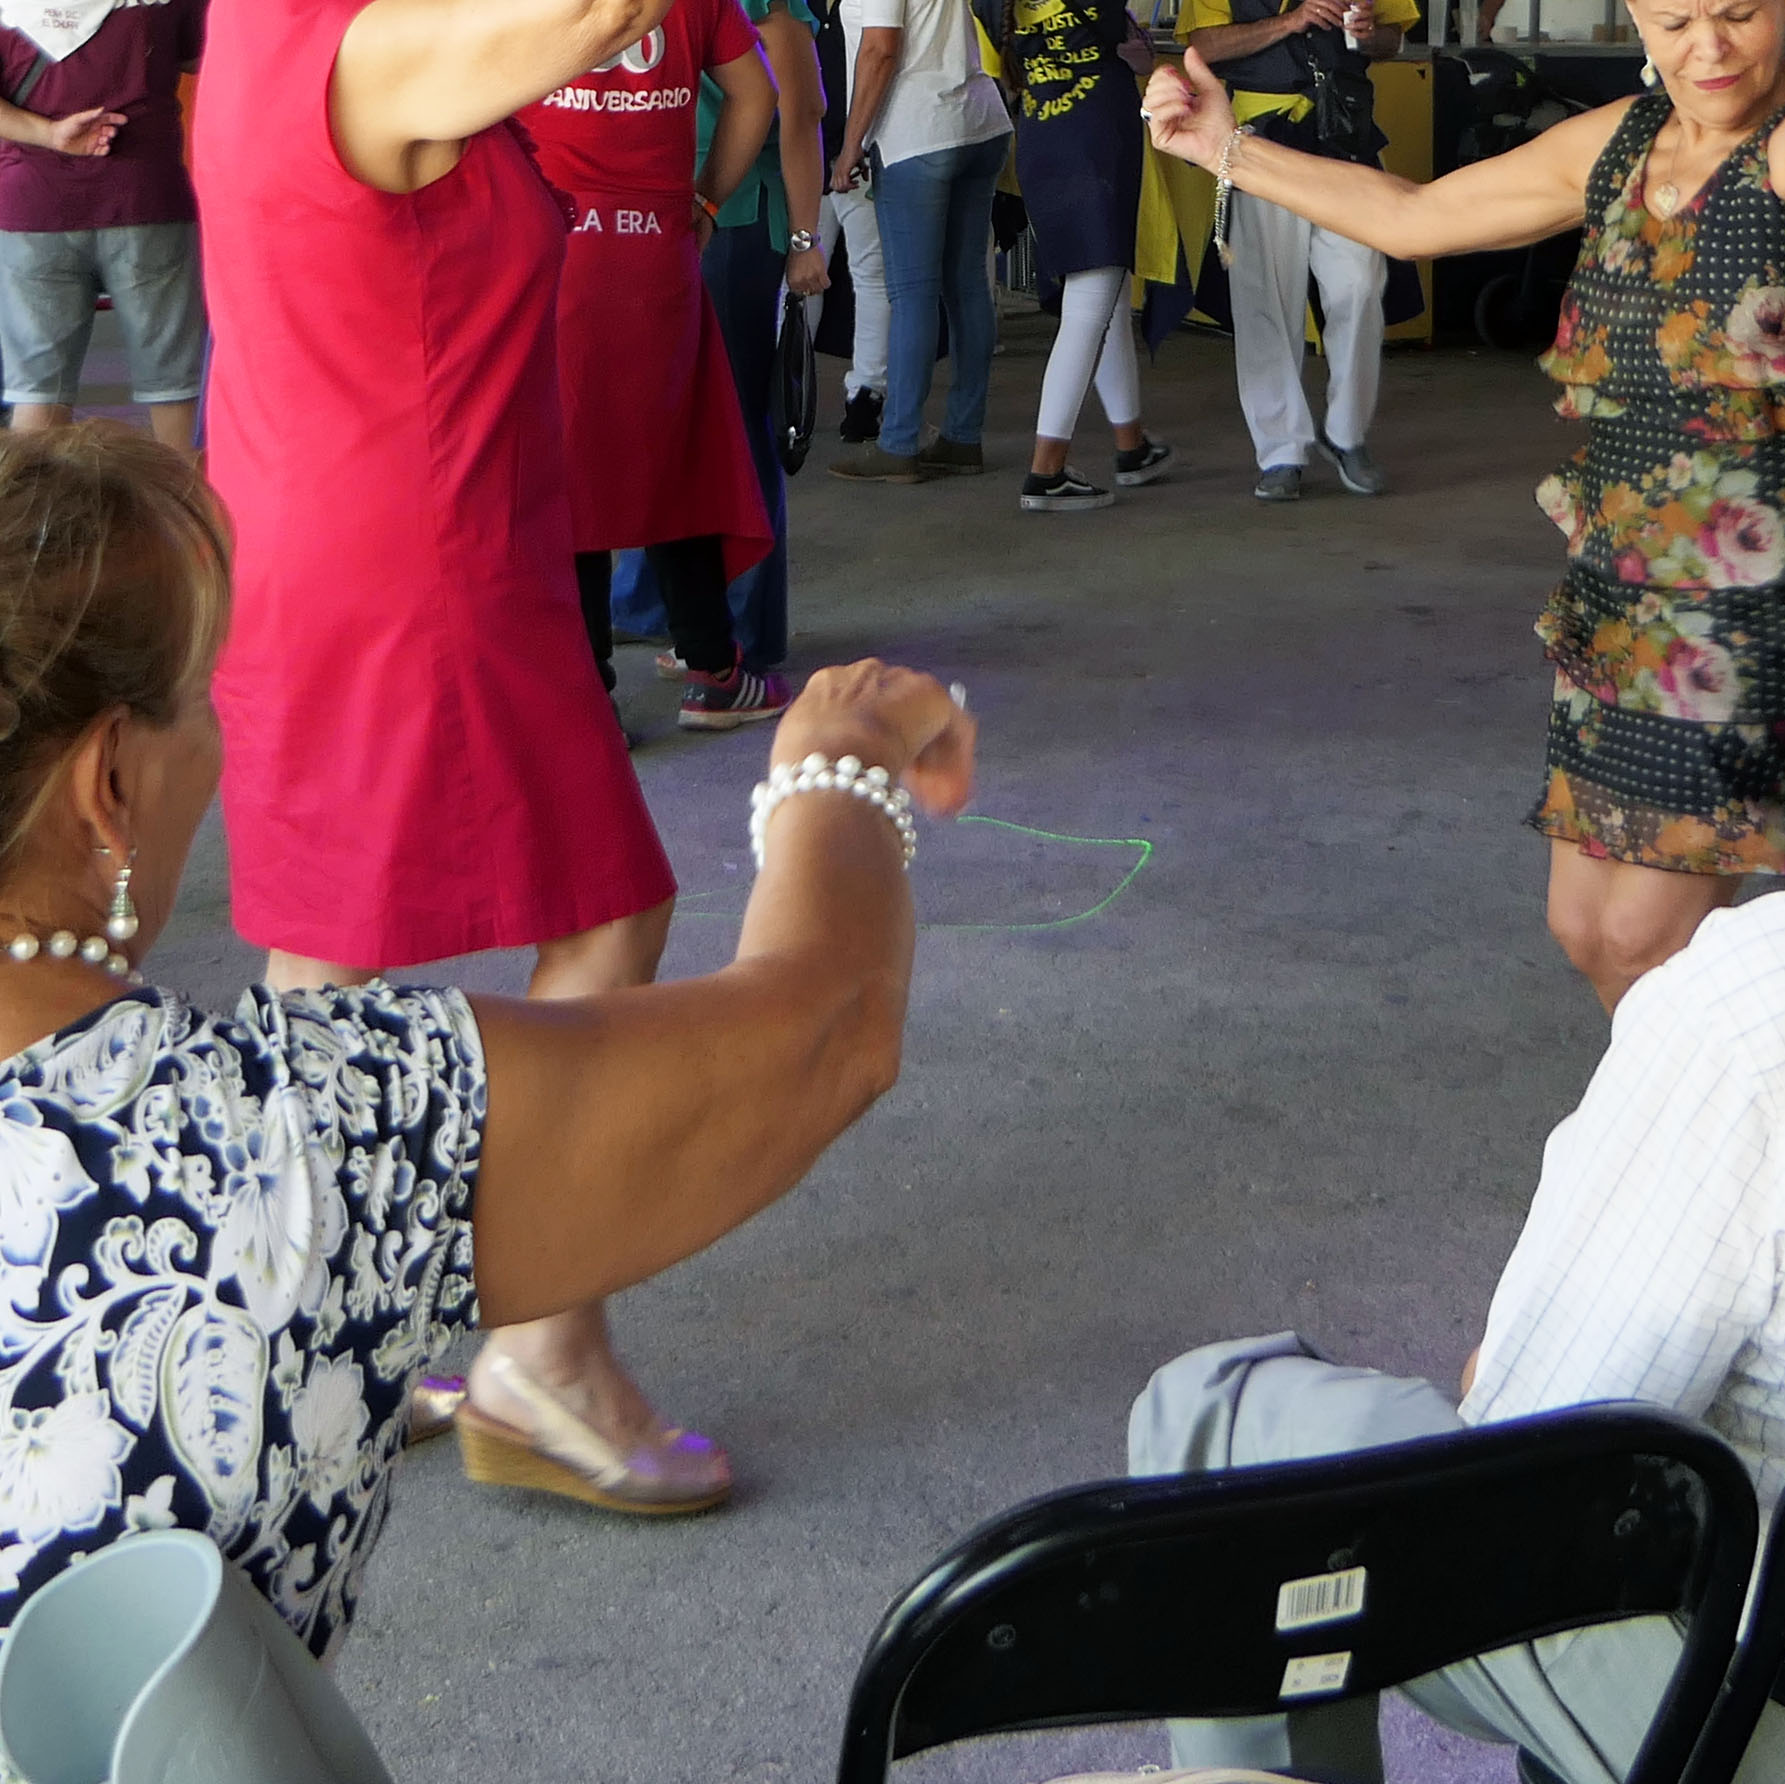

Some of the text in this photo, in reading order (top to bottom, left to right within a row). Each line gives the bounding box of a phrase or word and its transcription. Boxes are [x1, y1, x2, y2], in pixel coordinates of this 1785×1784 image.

[1043, 7, 1099, 34] JUSTS
[1045, 35, 1066, 50] DE
[543, 86, 692, 112] ANIVERSARIO
[616, 208, 662, 234] ERA
